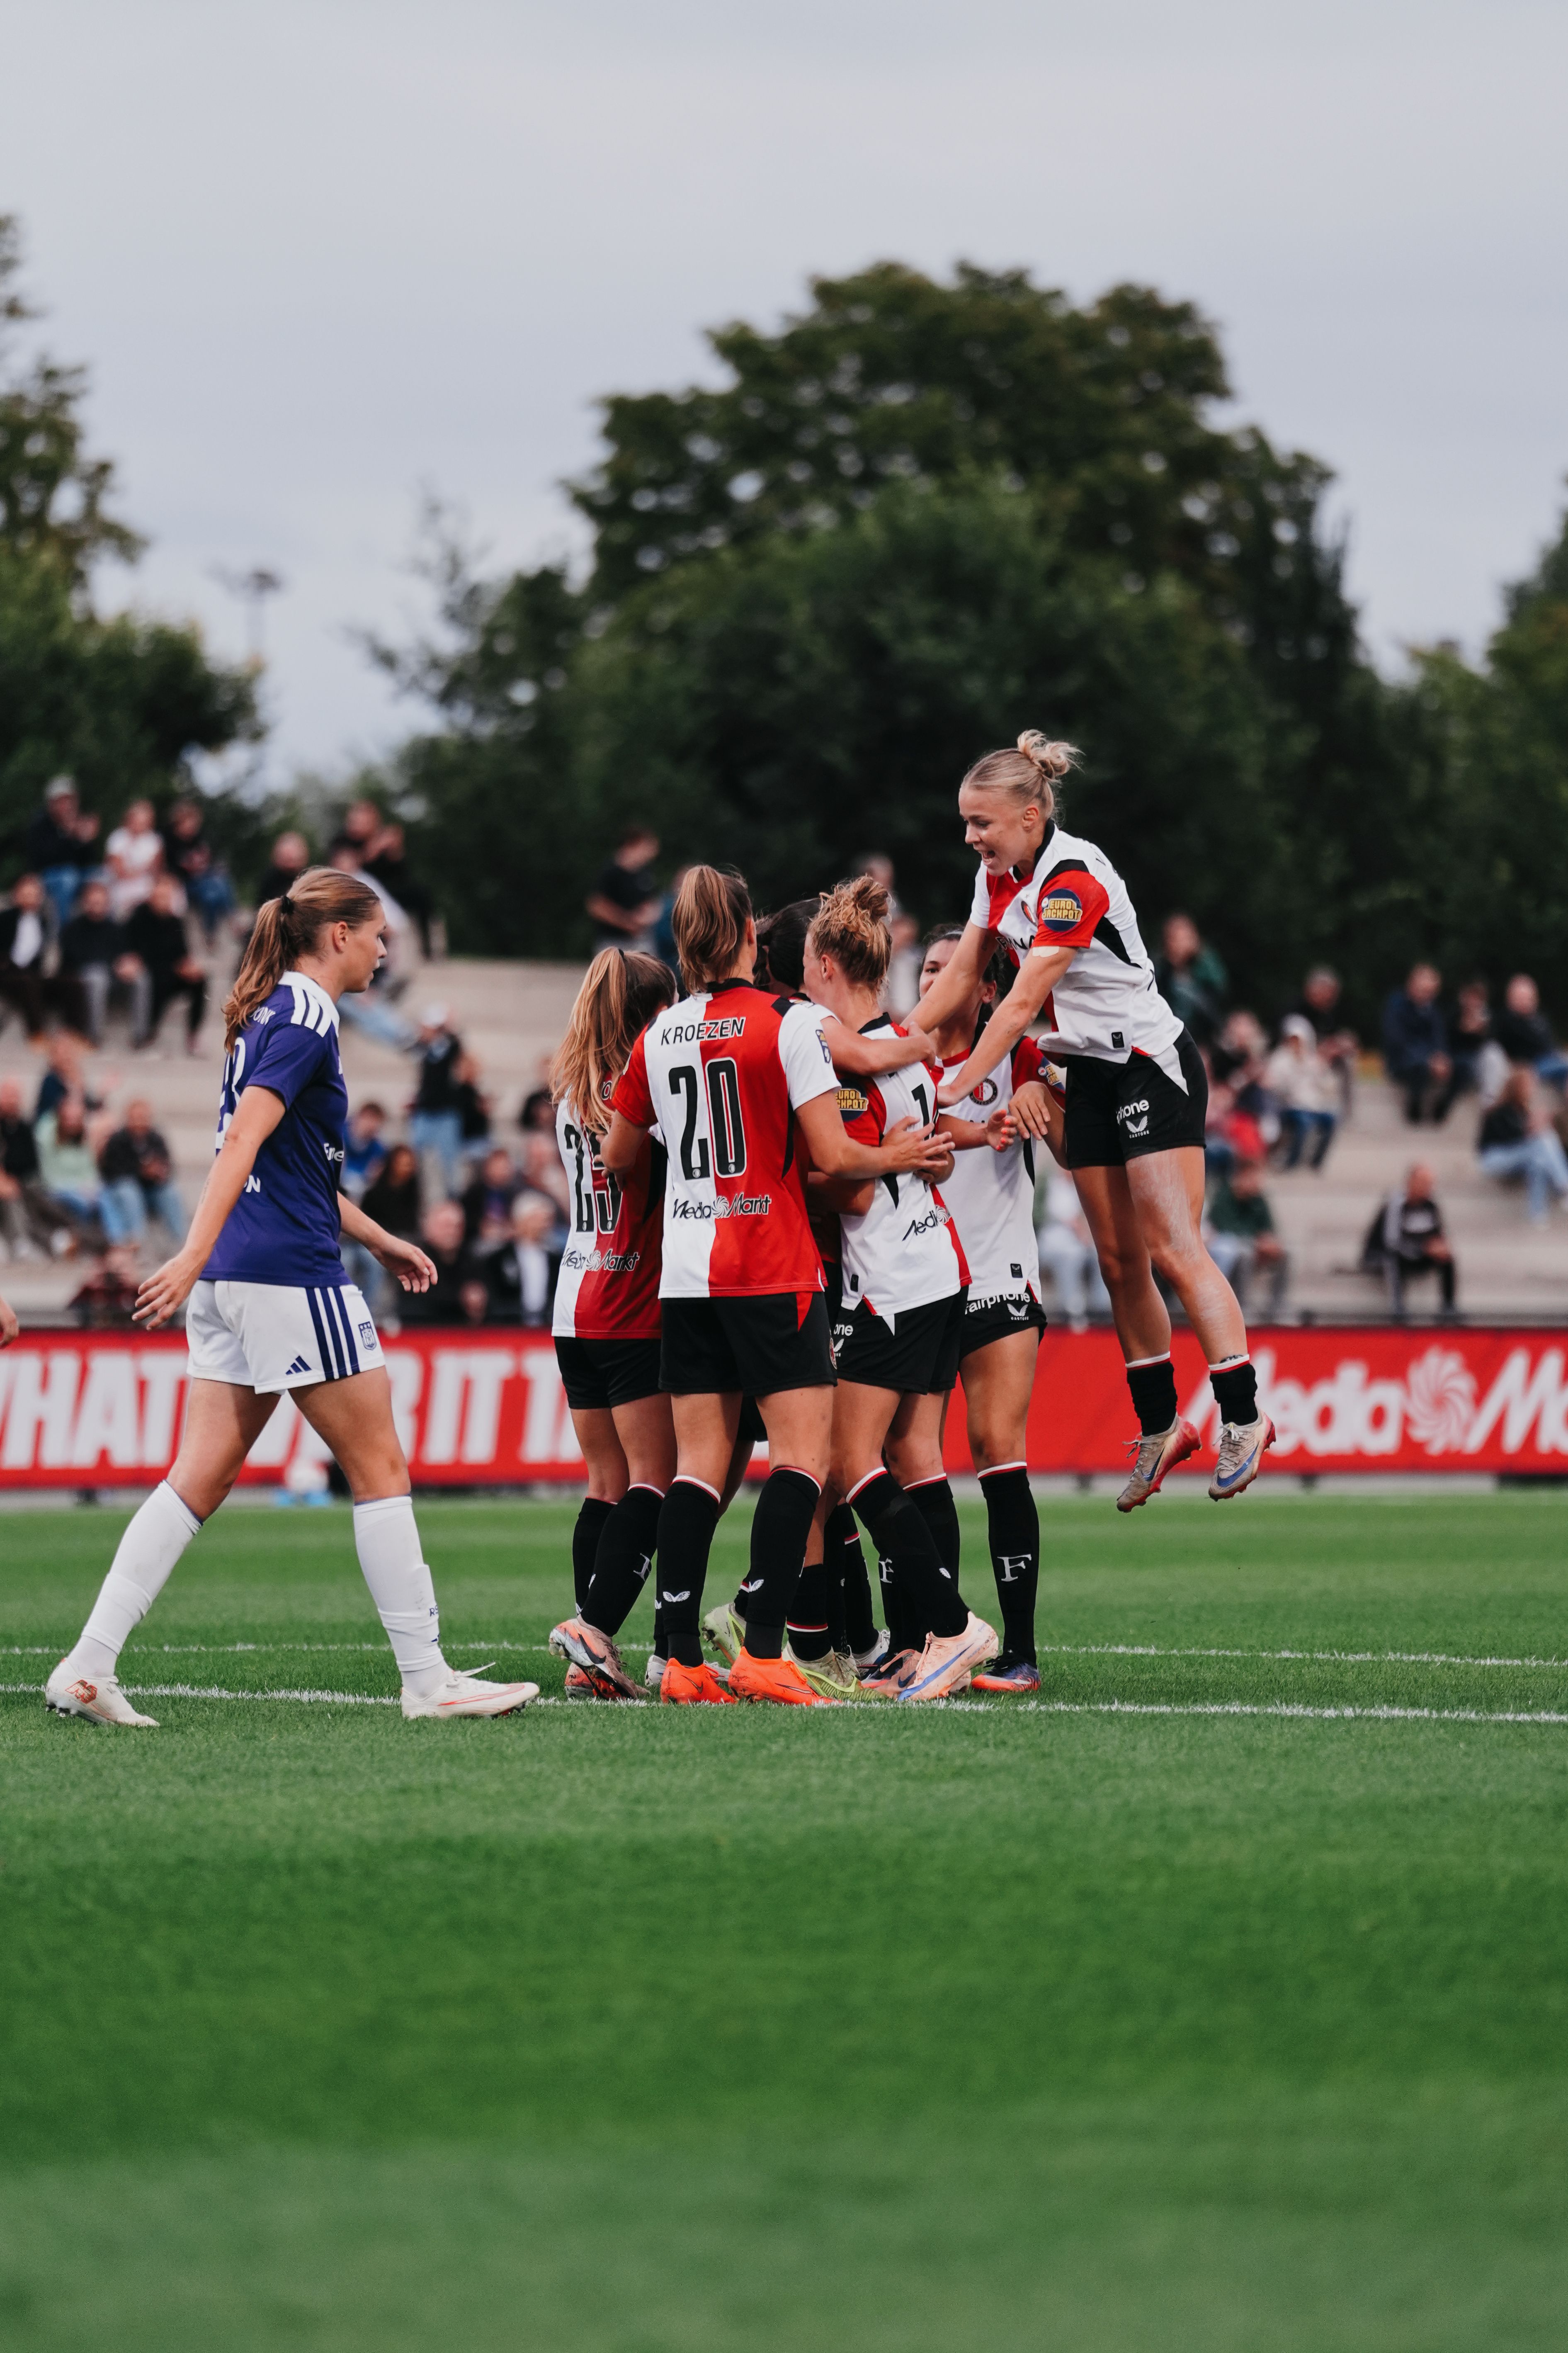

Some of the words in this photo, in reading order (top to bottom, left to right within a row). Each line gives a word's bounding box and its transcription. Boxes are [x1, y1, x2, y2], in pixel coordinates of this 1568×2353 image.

[1043, 909, 1079, 920] JACKPOT
[1049, 900, 1072, 910] EURO
[661, 1016, 746, 1046] KROEZEN
[668, 1057, 747, 1180] 20
[1129, 1130, 1150, 1139] CASTORE
[726, 1192, 771, 1217] Markt
[997, 1554, 1032, 1582] F
